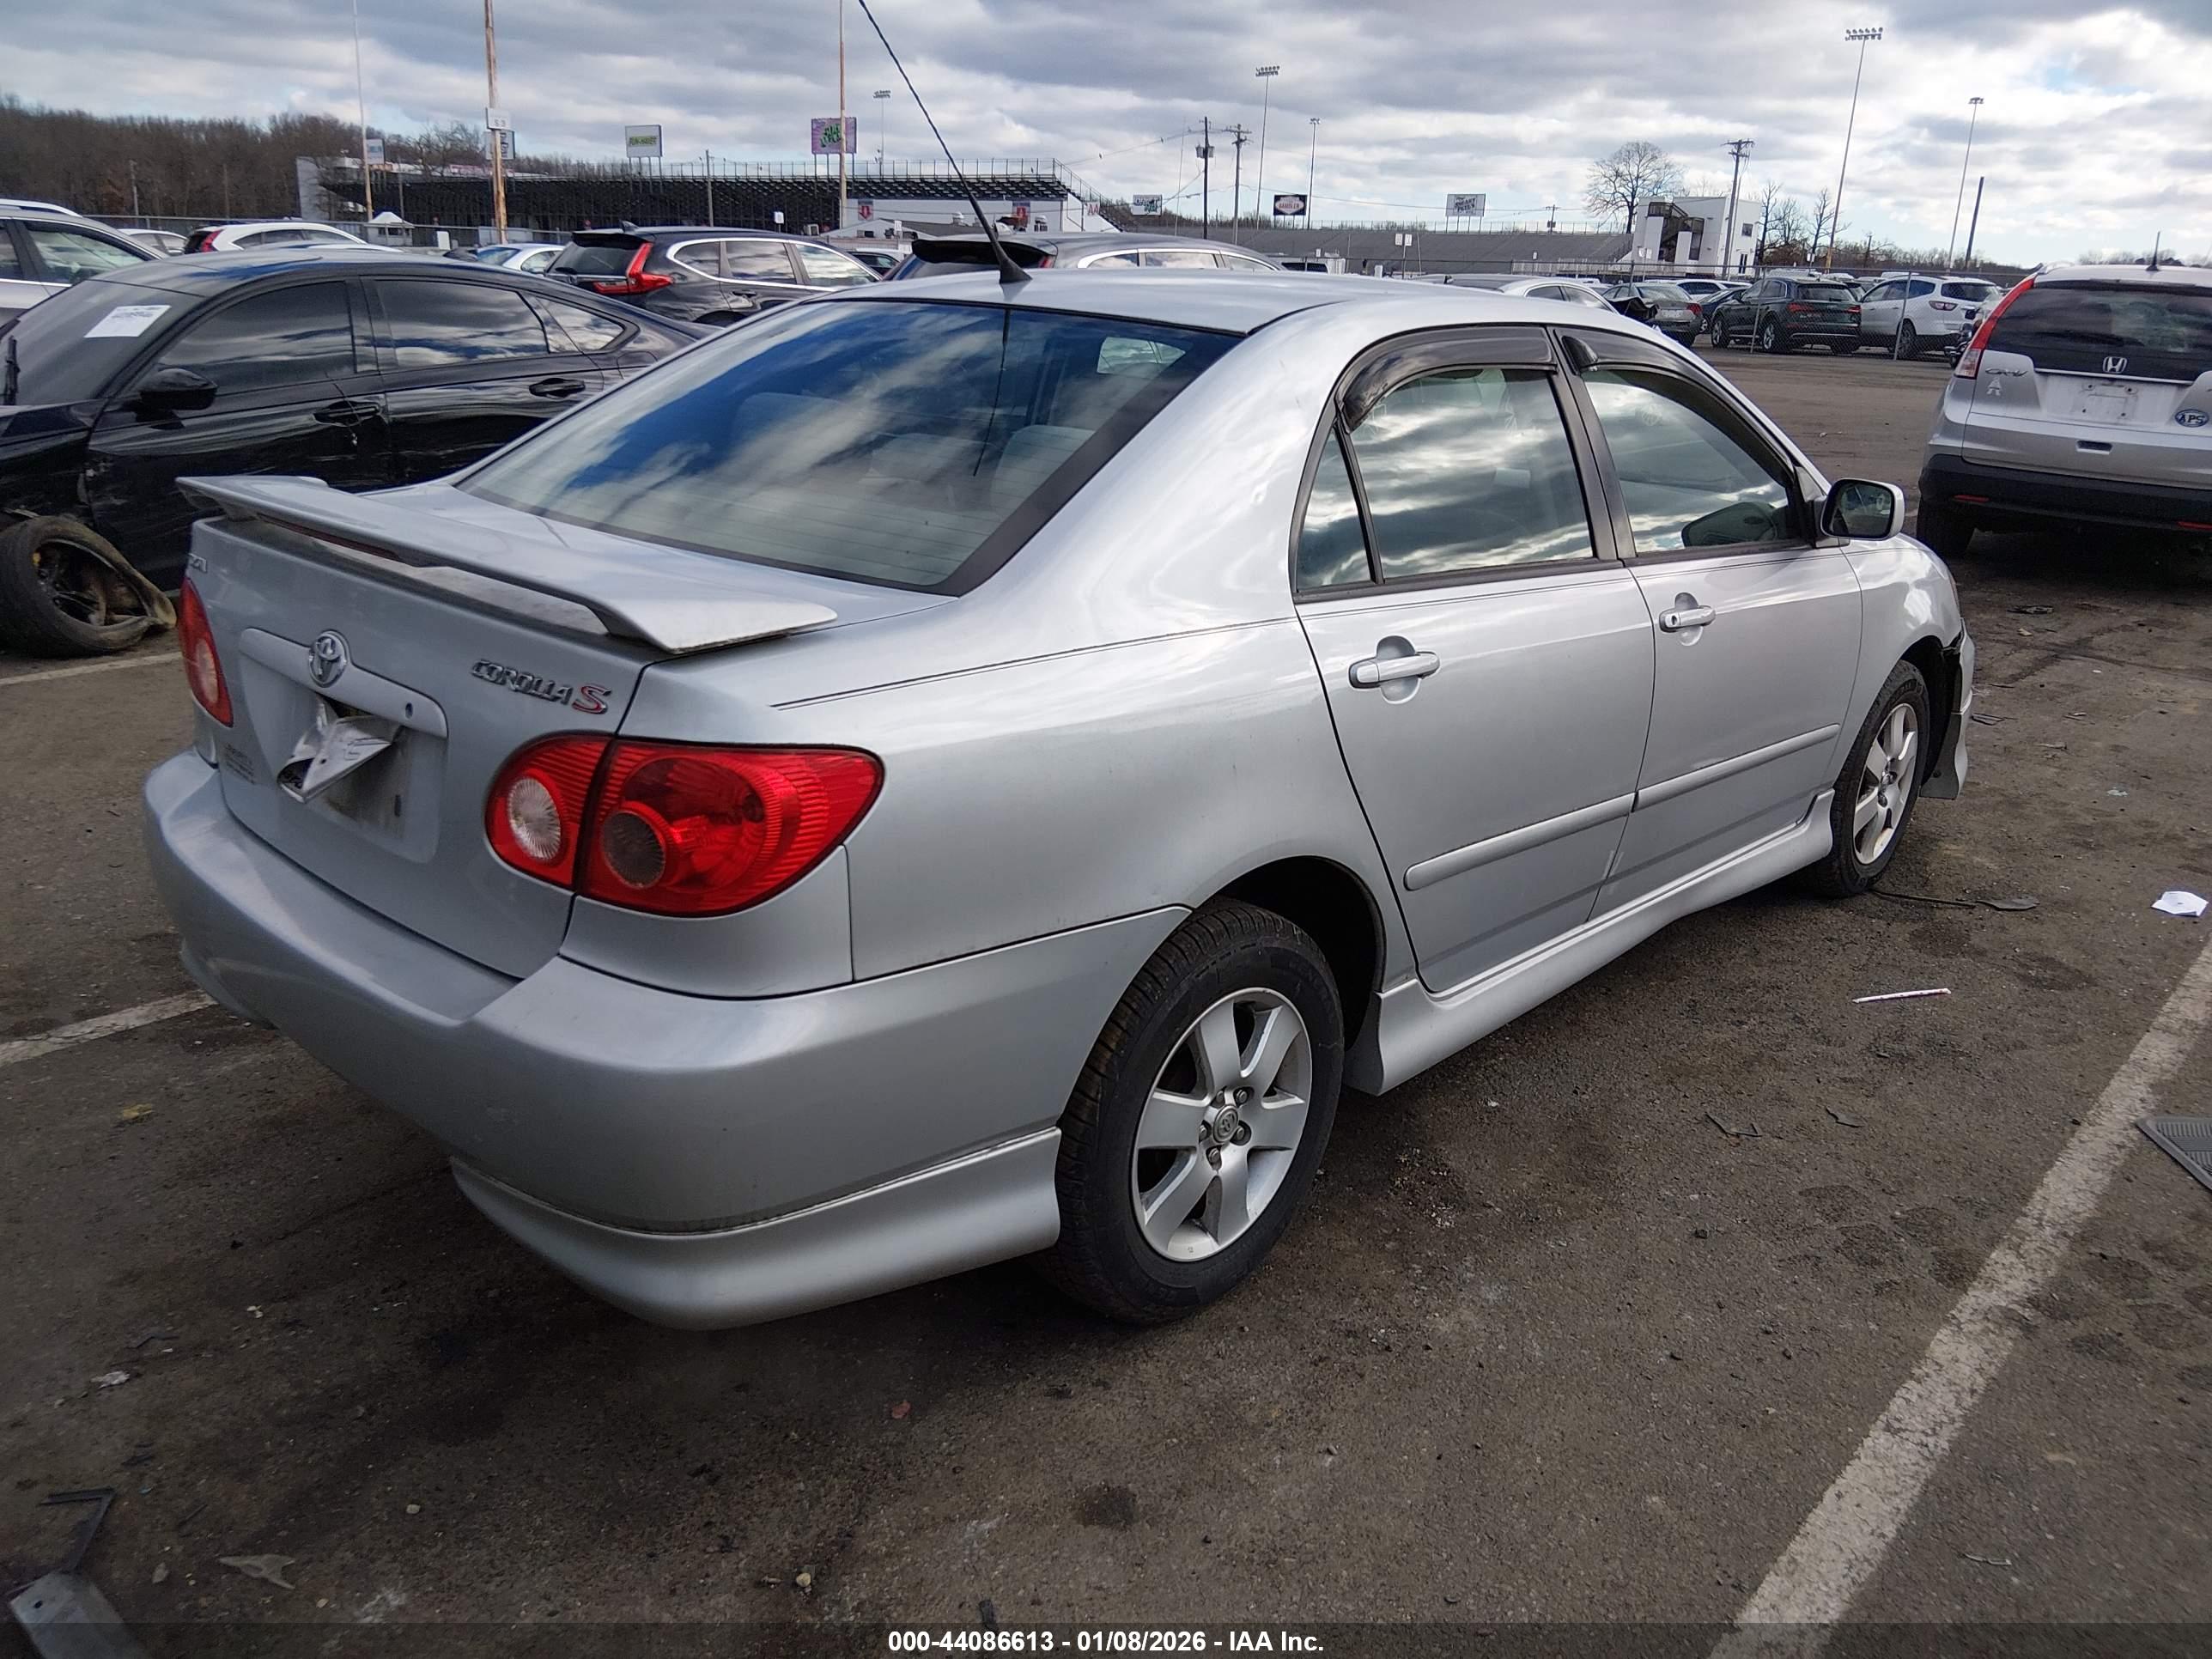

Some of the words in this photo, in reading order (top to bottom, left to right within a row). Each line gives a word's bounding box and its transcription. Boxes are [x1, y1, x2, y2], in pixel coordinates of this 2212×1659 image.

[2178, 412, 2206, 424] APS
[471, 659, 574, 706] COROLLA
[571, 684, 612, 714] S
